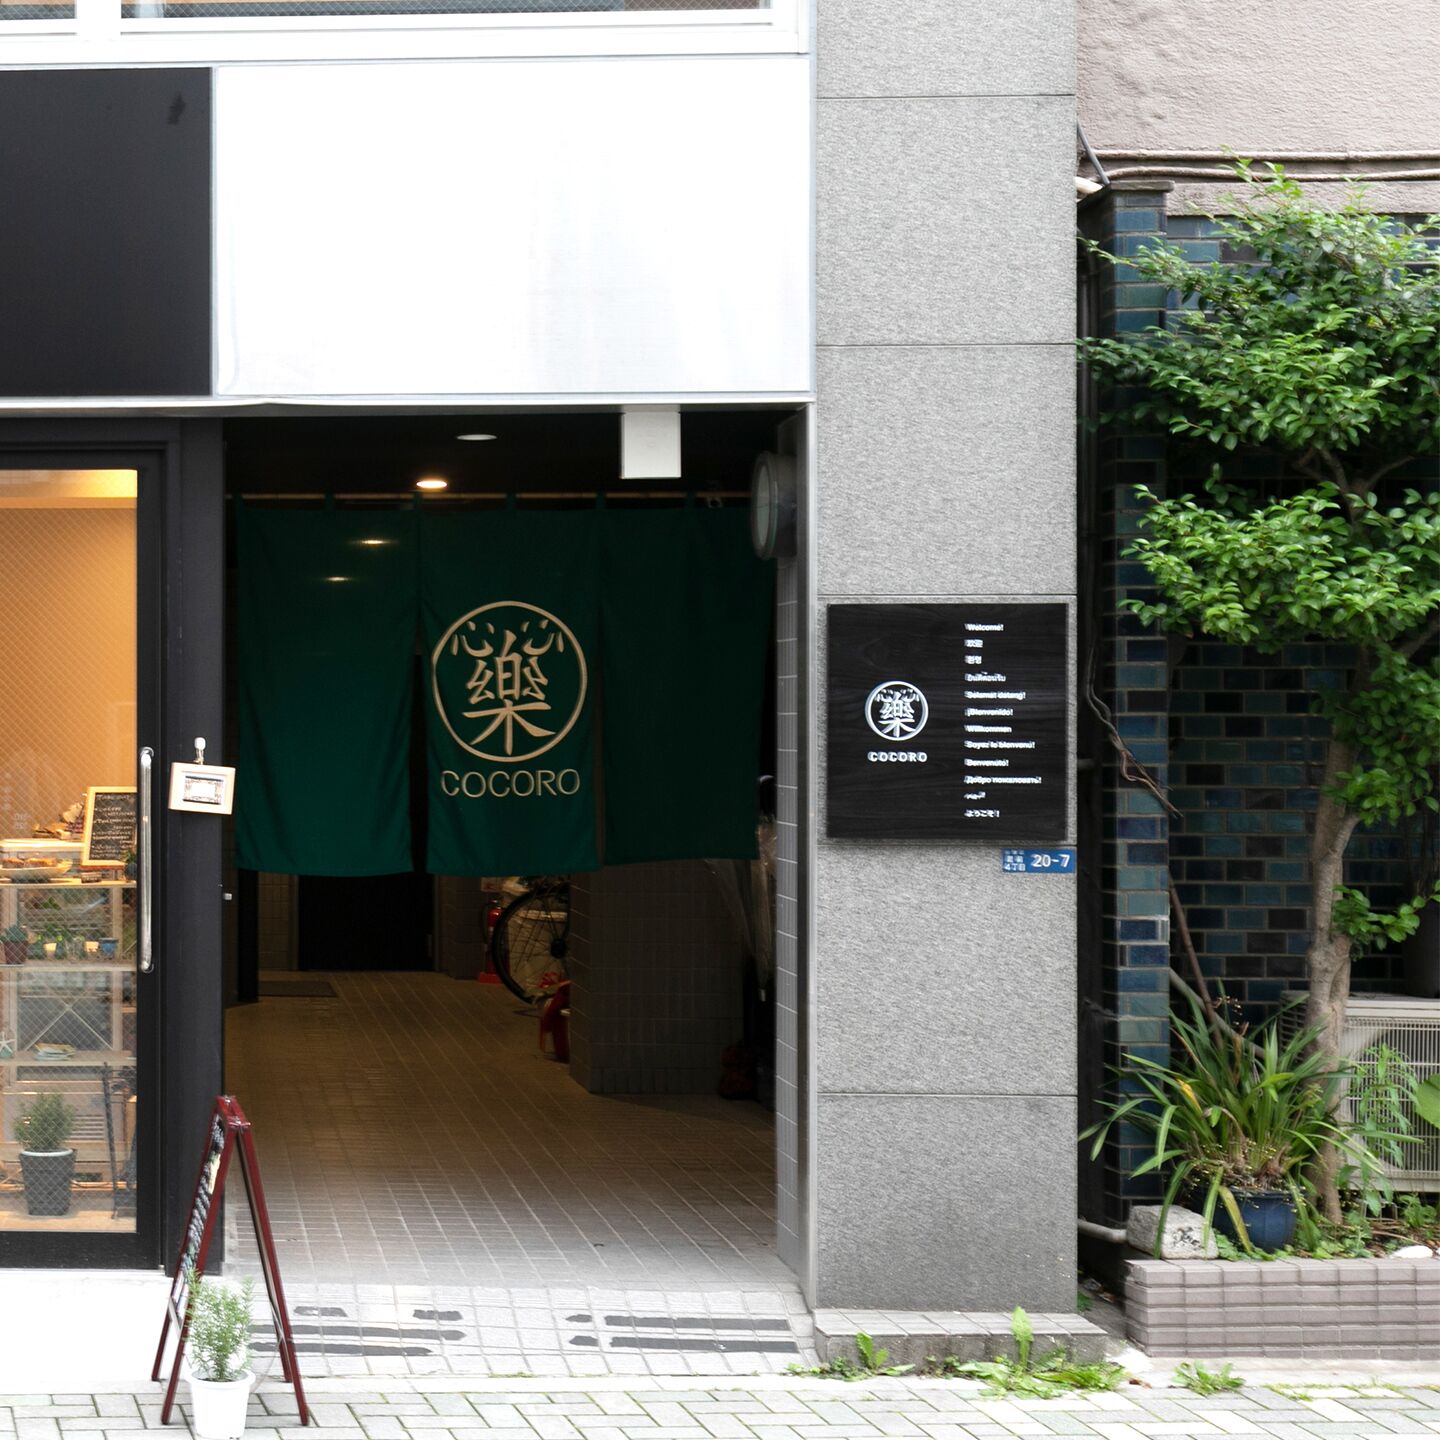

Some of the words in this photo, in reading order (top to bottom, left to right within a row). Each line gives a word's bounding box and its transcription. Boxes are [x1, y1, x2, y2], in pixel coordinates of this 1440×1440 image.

[868, 751, 927, 762] COCORO
[441, 768, 581, 798] COCORO
[1031, 854, 1070, 868] 20-7
